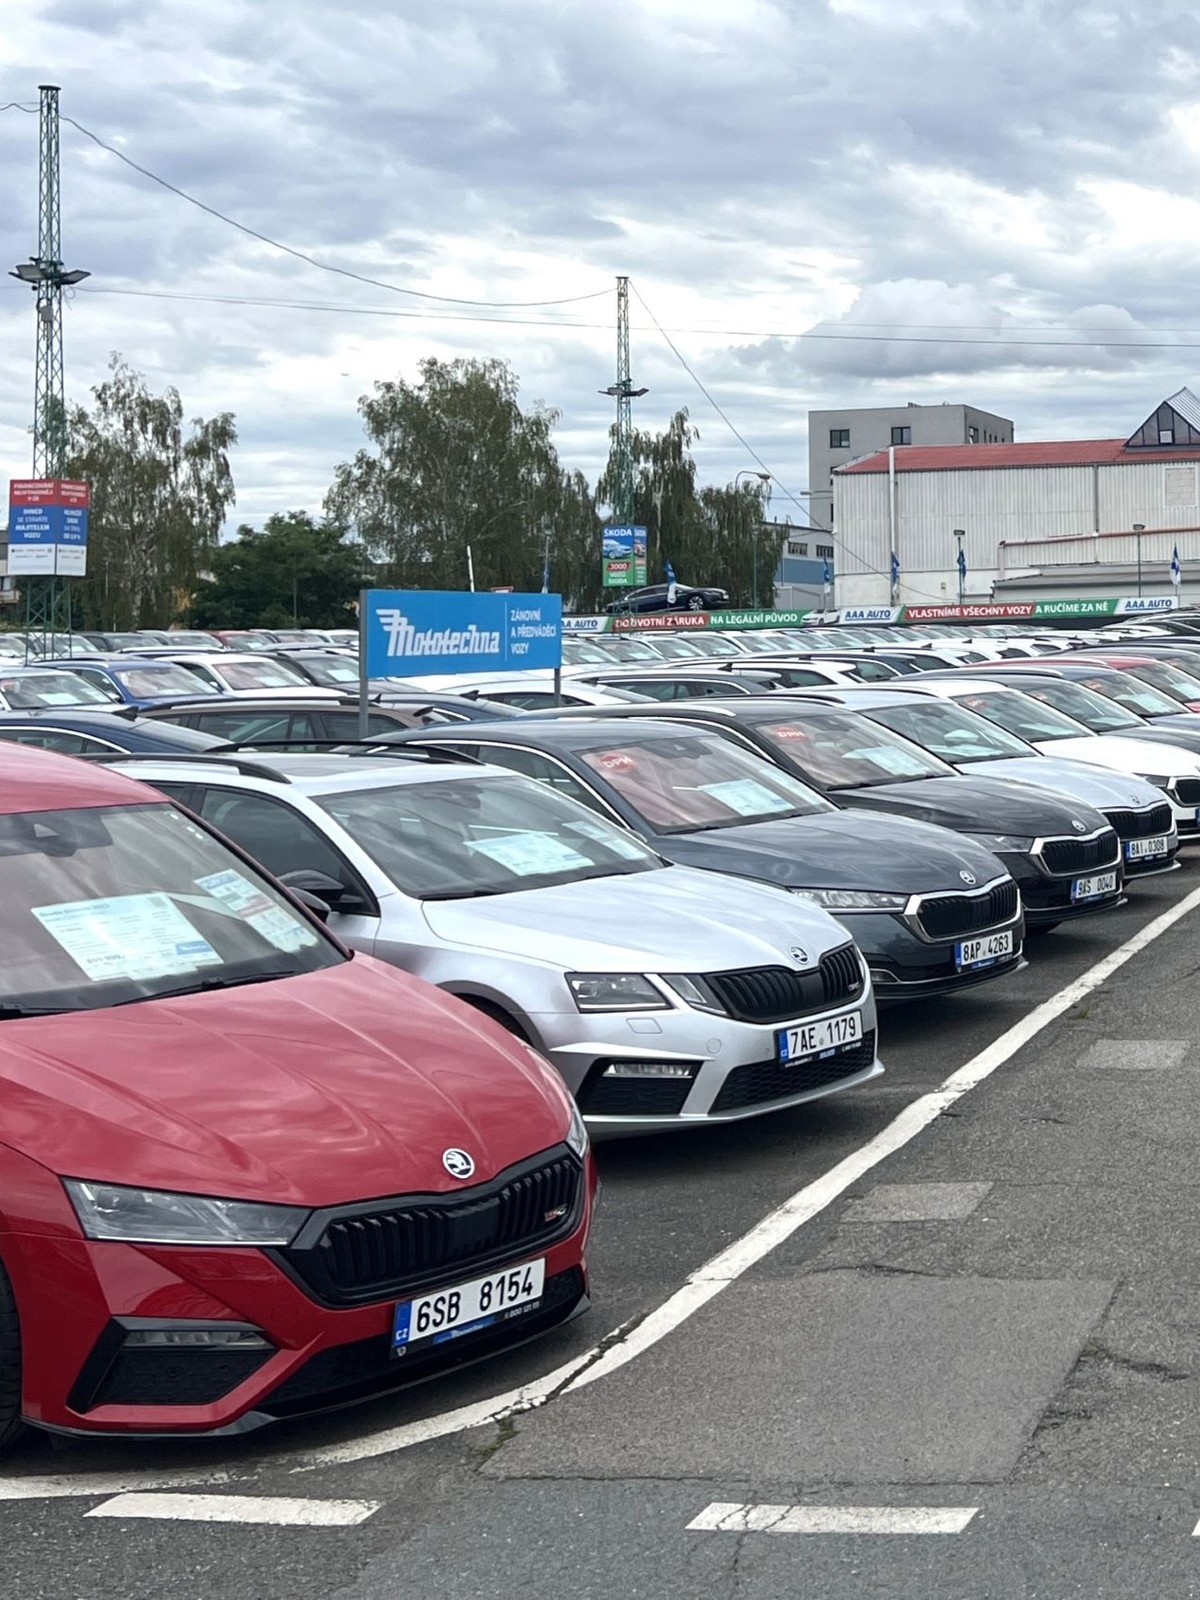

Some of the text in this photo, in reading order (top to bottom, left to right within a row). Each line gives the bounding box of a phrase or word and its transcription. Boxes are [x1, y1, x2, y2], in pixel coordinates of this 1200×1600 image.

[603, 528, 632, 537] ŠKODA
[609, 562, 628, 570] 3000
[908, 601, 1108, 618] VLASTNÍME VŠECHNY VOZY A RUČÍME ZA NĚ
[1125, 599, 1172, 608] AAA AUTO
[510, 607, 542, 621] ZÁNOVNÍ
[667, 615, 704, 627] ZÁRUKA
[710, 615, 724, 624] NA
[726, 613, 763, 624] LEGÁLNÍ
[765, 612, 798, 623] PŮVOD
[845, 609, 890, 618] AAA AUTO
[574, 619, 598, 628] AUTO
[376, 609, 500, 657] Mototechna
[511, 629, 516, 638] A
[517, 624, 557, 638] PŘEDVÁDĚCÍ
[511, 643, 529, 654] VOZY
[602, 755, 633, 768] DPH
[963, 934, 1009, 962] 8AP 4263
[791, 1027, 817, 1055] 7AE
[827, 1016, 856, 1044] 1179
[395, 1328, 408, 1341] CZ
[416, 1291, 461, 1333] 6SB
[478, 1266, 533, 1312] 8154
